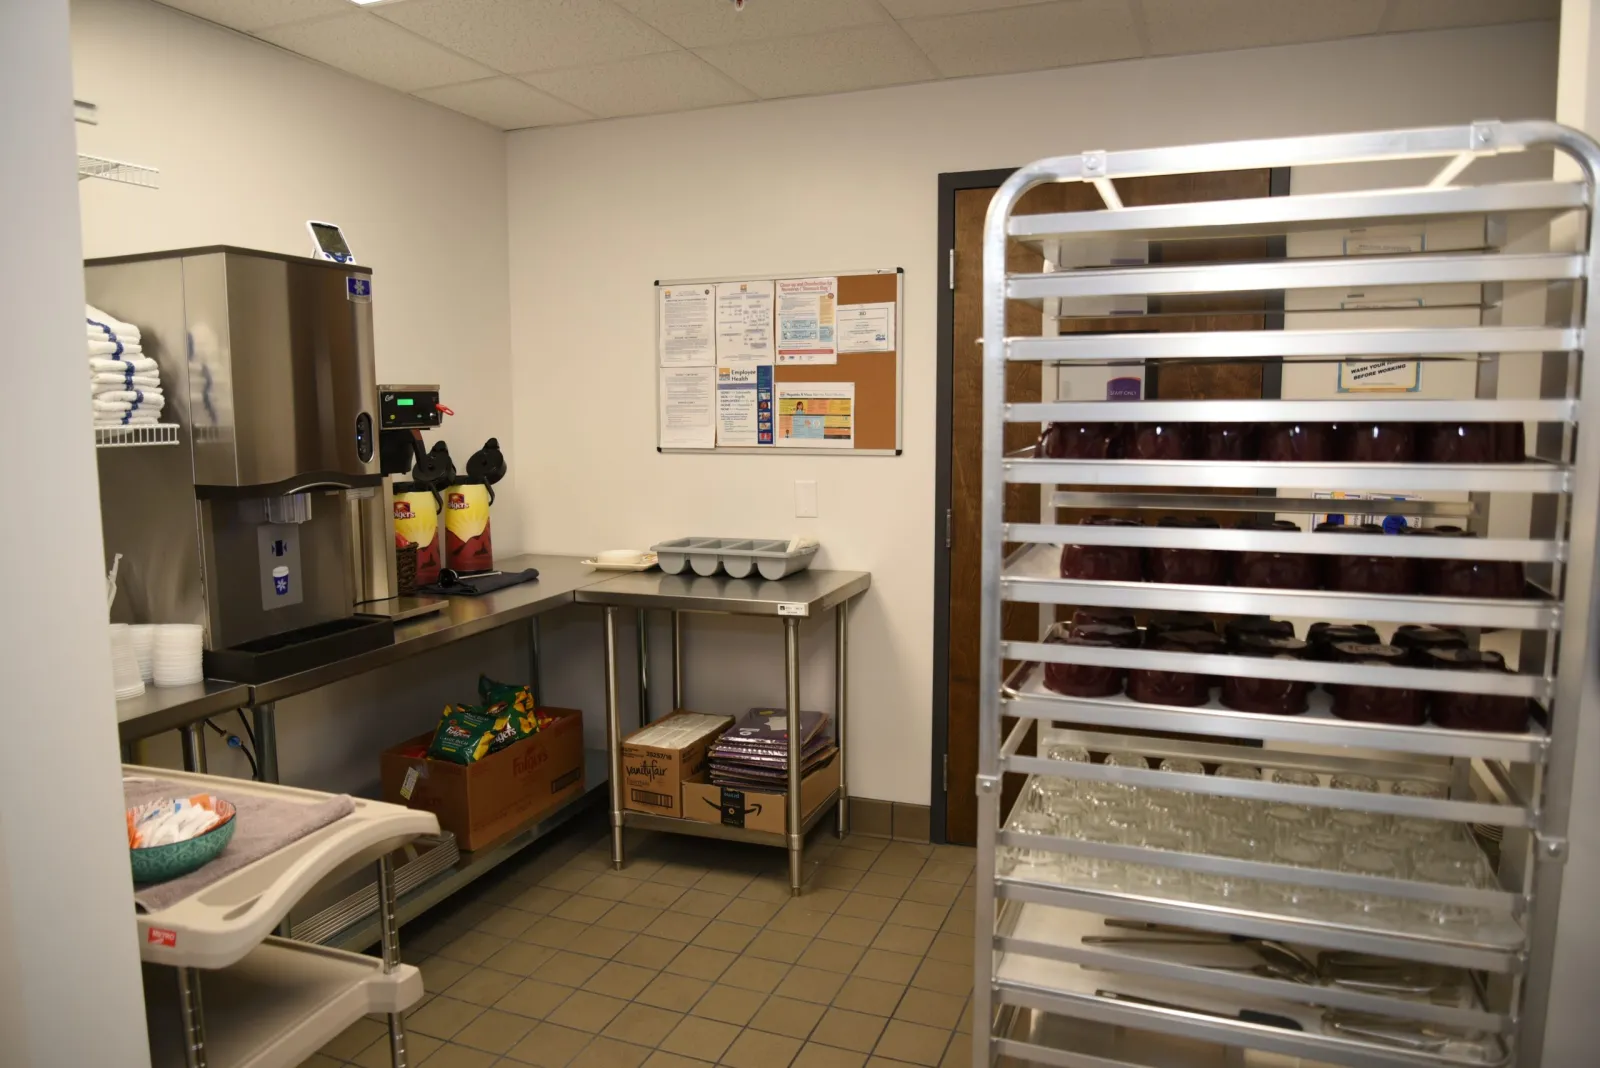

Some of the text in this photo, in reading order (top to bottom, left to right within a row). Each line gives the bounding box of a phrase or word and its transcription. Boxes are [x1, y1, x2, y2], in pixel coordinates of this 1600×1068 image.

[1351, 366, 1368, 374] WASH
[1370, 362, 1386, 370] YOUR
[1353, 370, 1377, 380] BEFORE
[1378, 363, 1407, 374] WORKING
[446, 726, 471, 738] Folgers
[513, 752, 548, 778] Folgers
